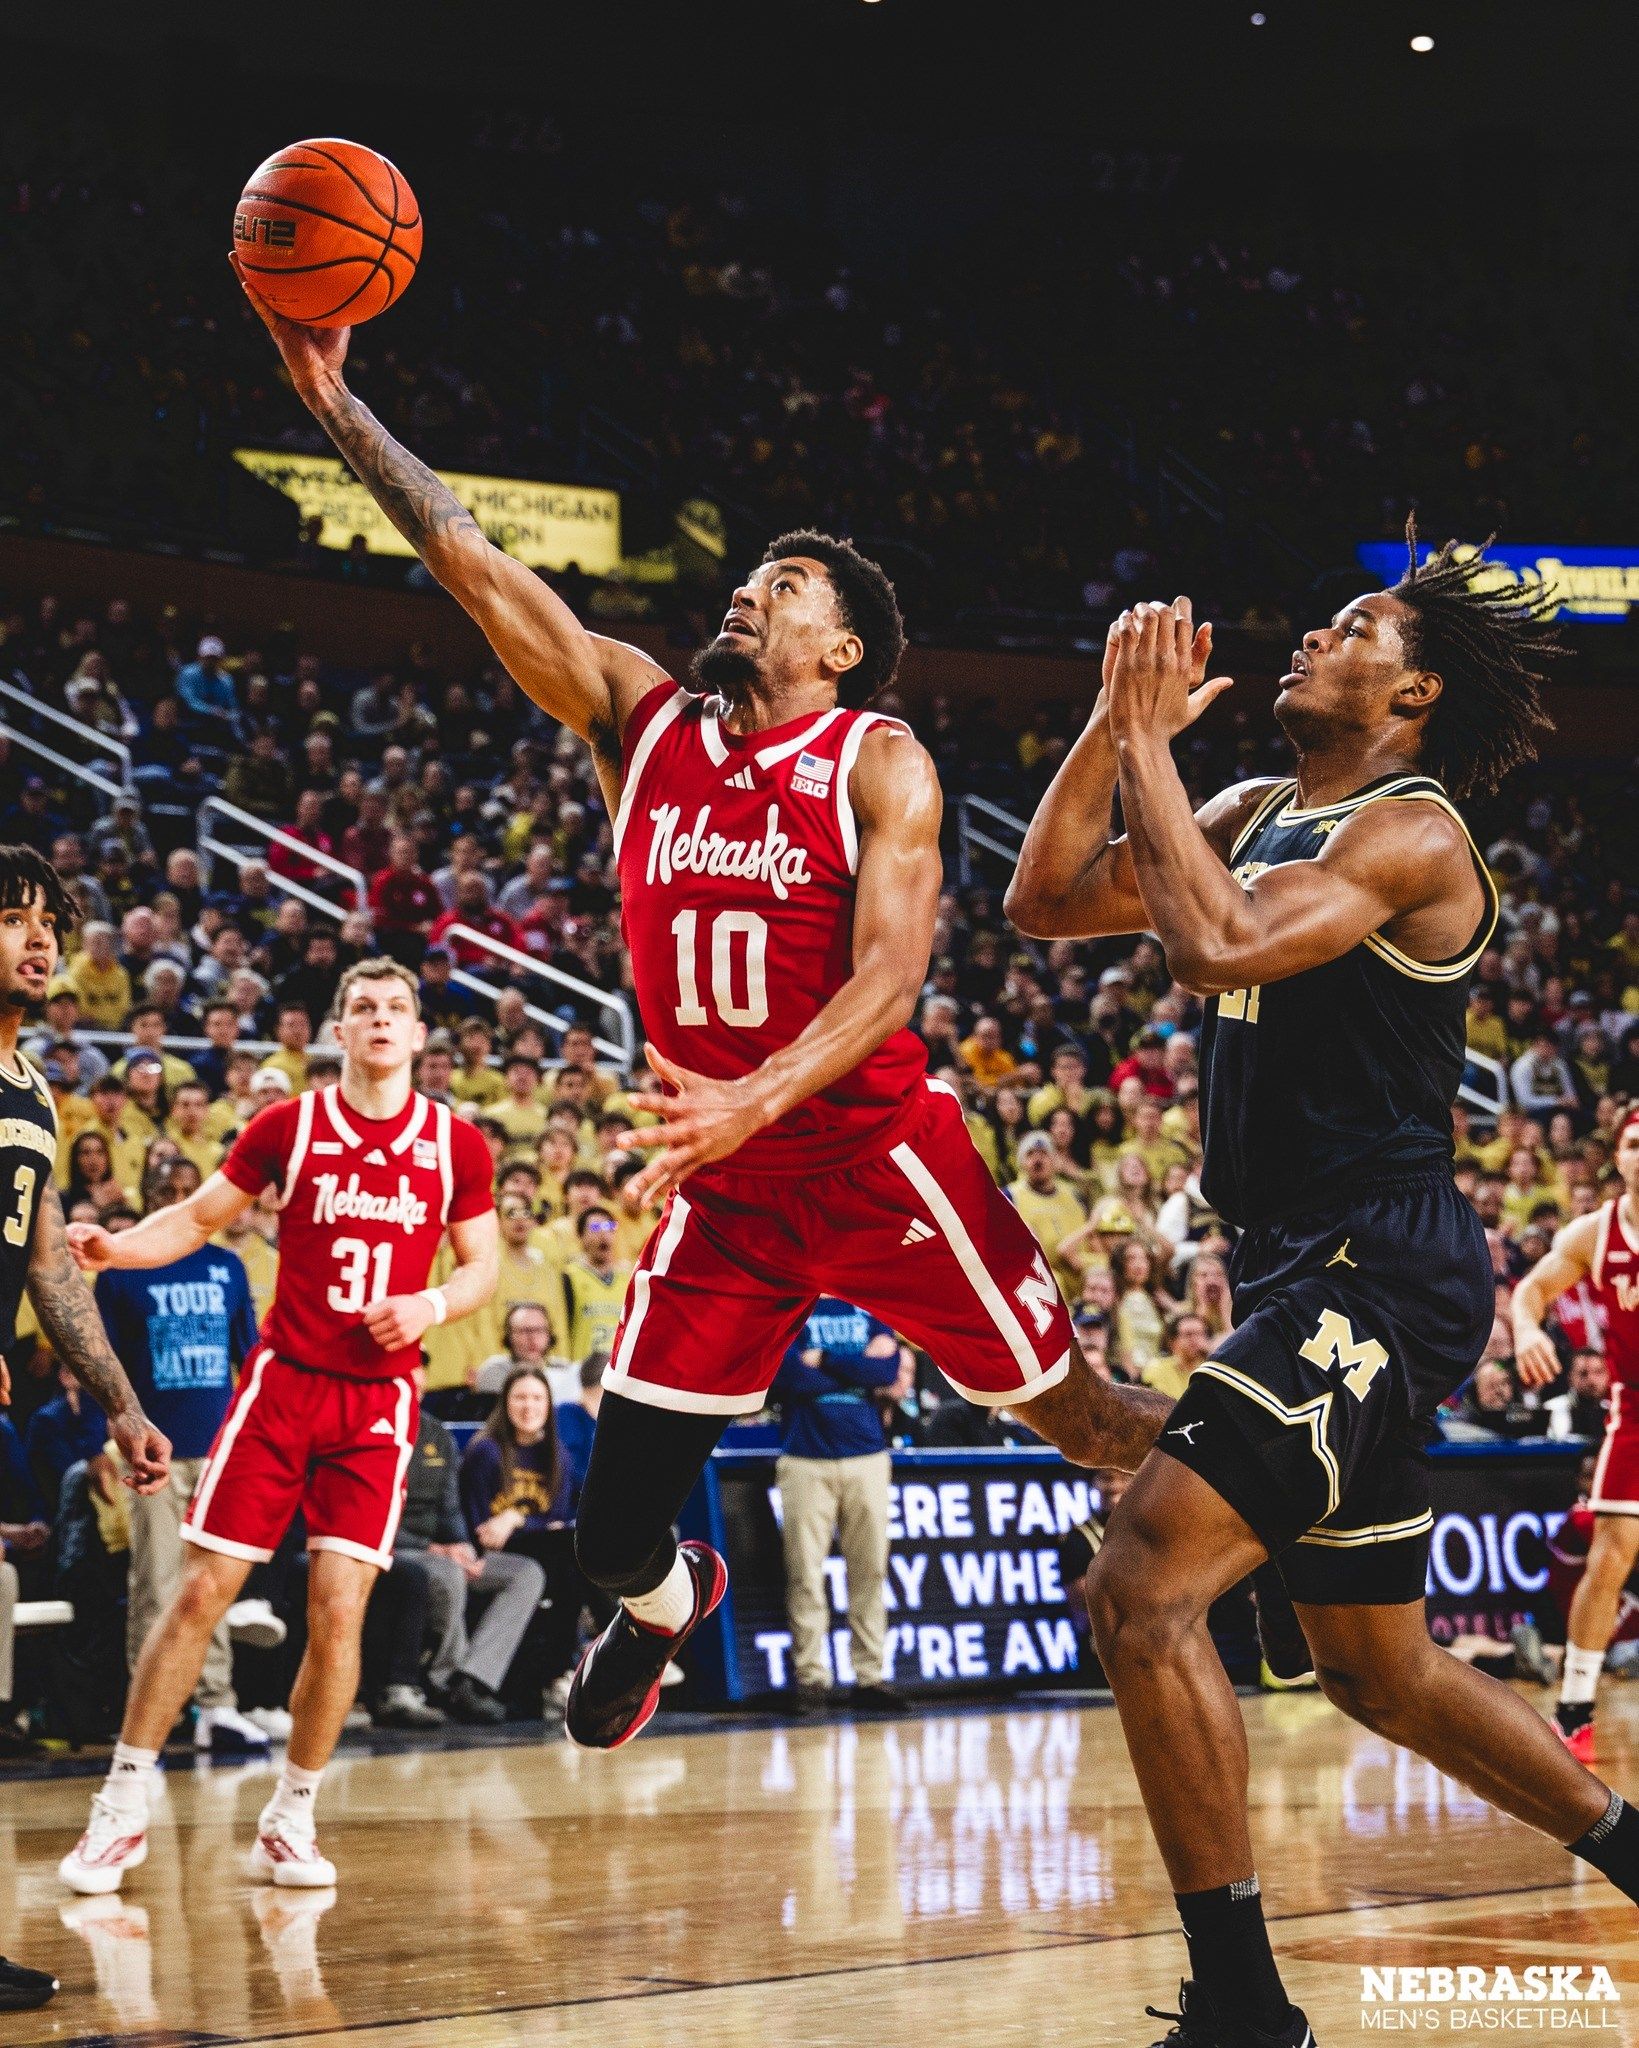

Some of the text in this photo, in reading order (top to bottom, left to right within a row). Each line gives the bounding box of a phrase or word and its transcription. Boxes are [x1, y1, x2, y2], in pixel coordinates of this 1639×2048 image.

[233, 213, 296, 247] ELITE
[473, 489, 613, 521] MICHIGAN
[646, 803, 811, 900] Nebraska
[672, 909, 769, 1028] 10
[3, 1165, 36, 1247] 3
[312, 1173, 428, 1234] Nebraska
[147, 1281, 227, 1317] YOUR
[327, 1237, 393, 1313] 31
[1013, 1247, 1058, 1338] N
[806, 1315, 869, 1345] YOUR
[1298, 1308, 1390, 1403] M
[940, 1549, 1067, 1608] WHE
[1425, 1511, 1568, 1597] OIC
[1003, 1617, 1079, 1676] AW
